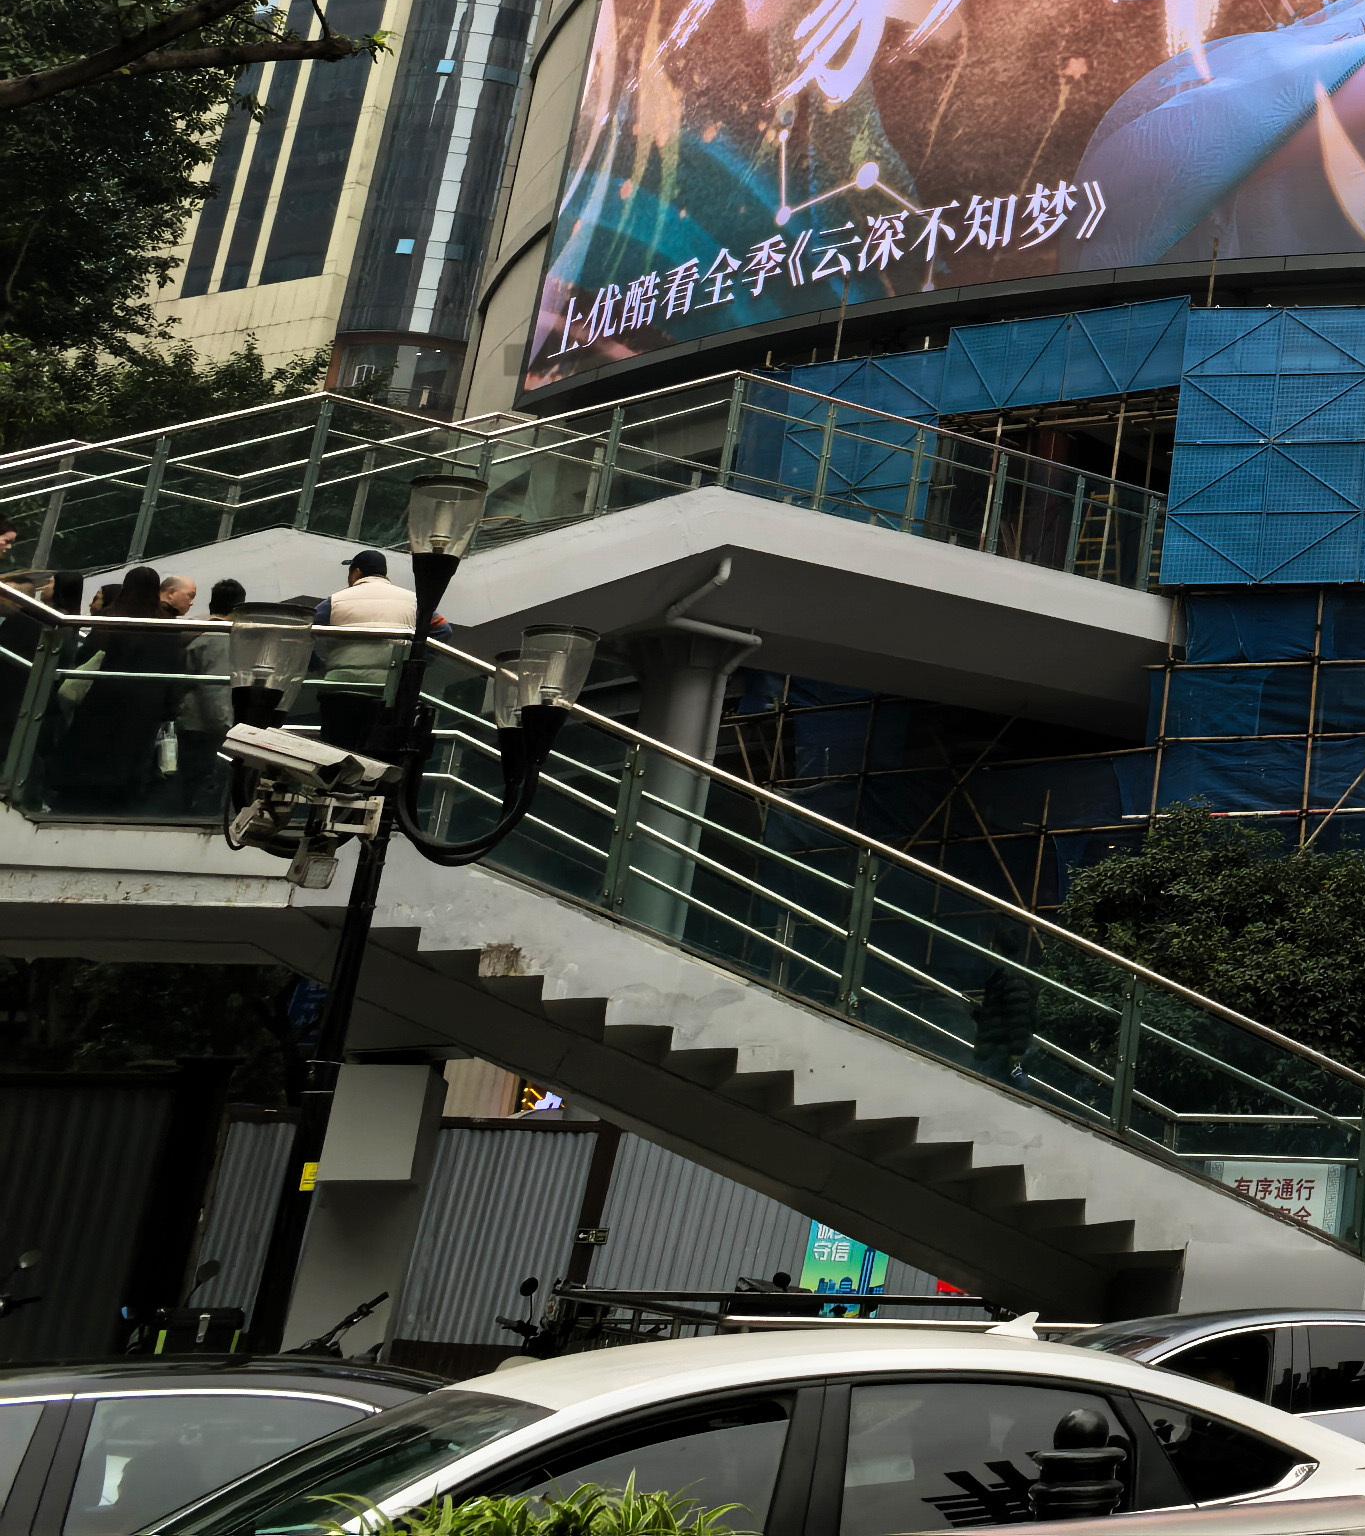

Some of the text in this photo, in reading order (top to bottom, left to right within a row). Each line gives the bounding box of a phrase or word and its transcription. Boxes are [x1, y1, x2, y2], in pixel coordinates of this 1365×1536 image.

[546, 178, 1108, 361] 上优酷看全季《云深不知梦》
[1234, 1176, 1316, 1202] 有序通行
[812, 1242, 851, 1261] 守信
